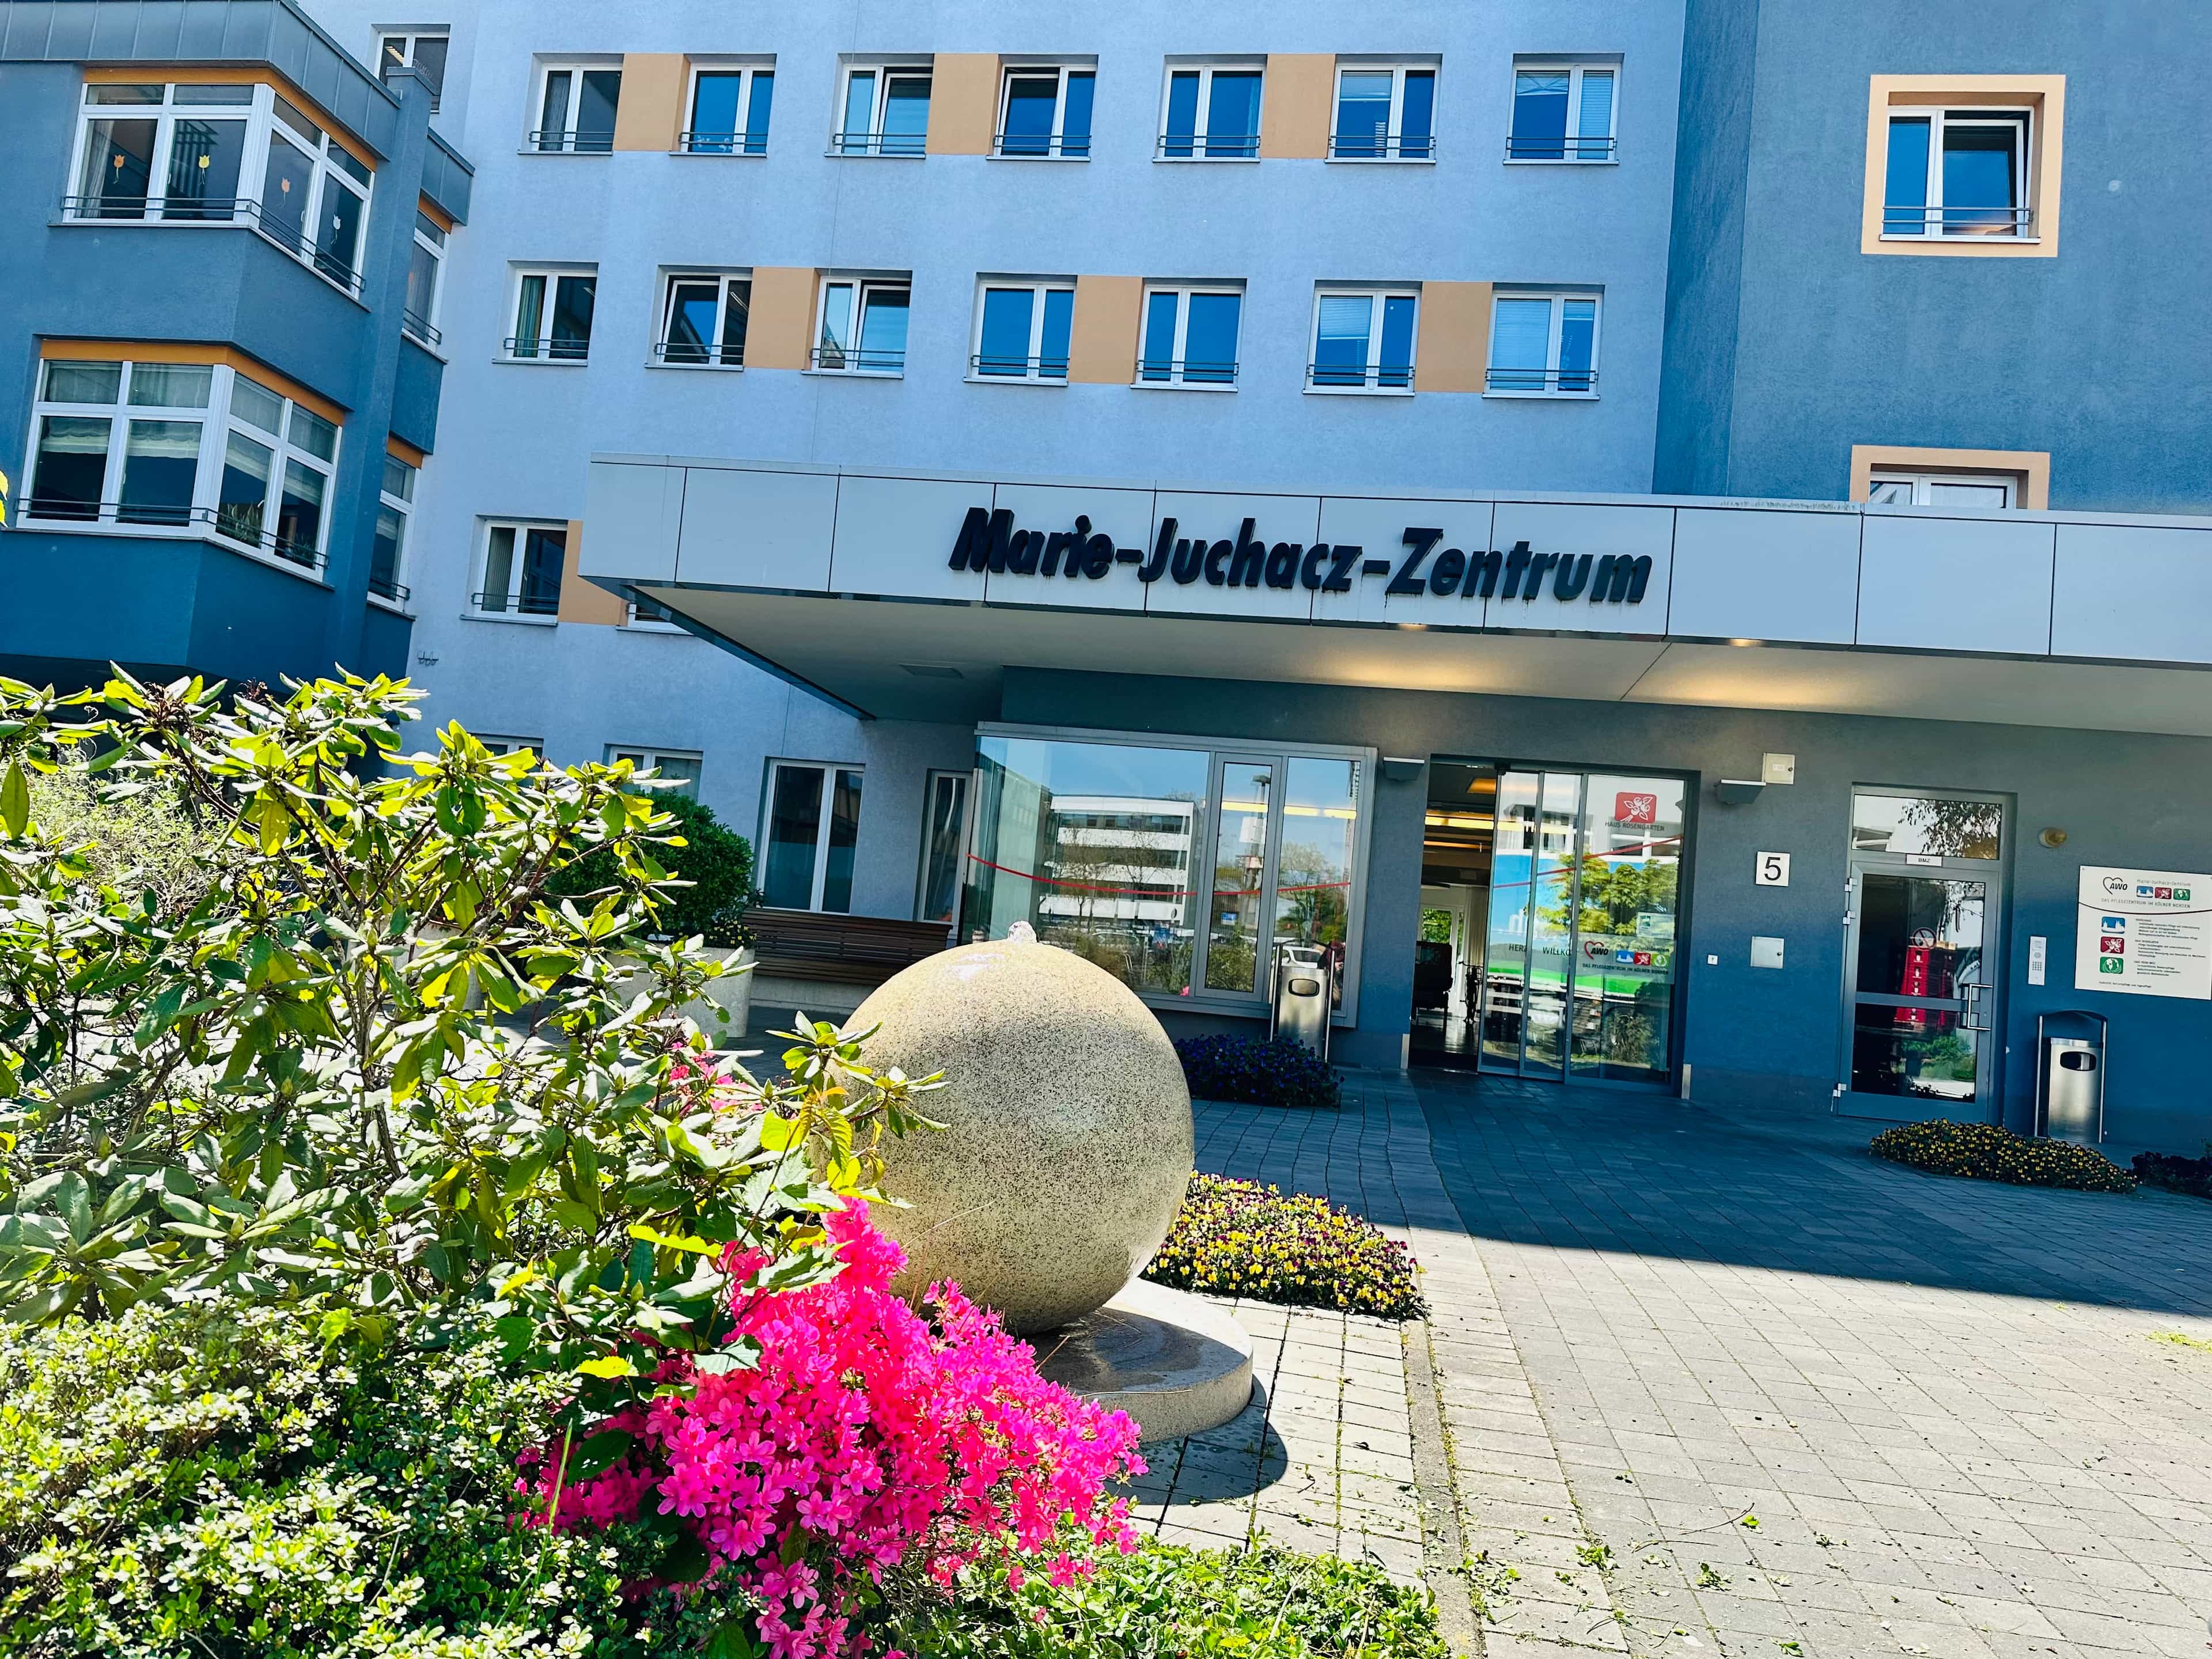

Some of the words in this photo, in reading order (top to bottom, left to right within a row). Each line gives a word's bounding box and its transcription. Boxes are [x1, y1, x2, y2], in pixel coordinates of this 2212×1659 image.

[948, 507, 1653, 603] Marie-Juchacz-Zentrum
[1622, 823, 1664, 831] ROSENGARTEN
[1764, 857, 1781, 881] 5
[2109, 882, 2128, 891] AWO
